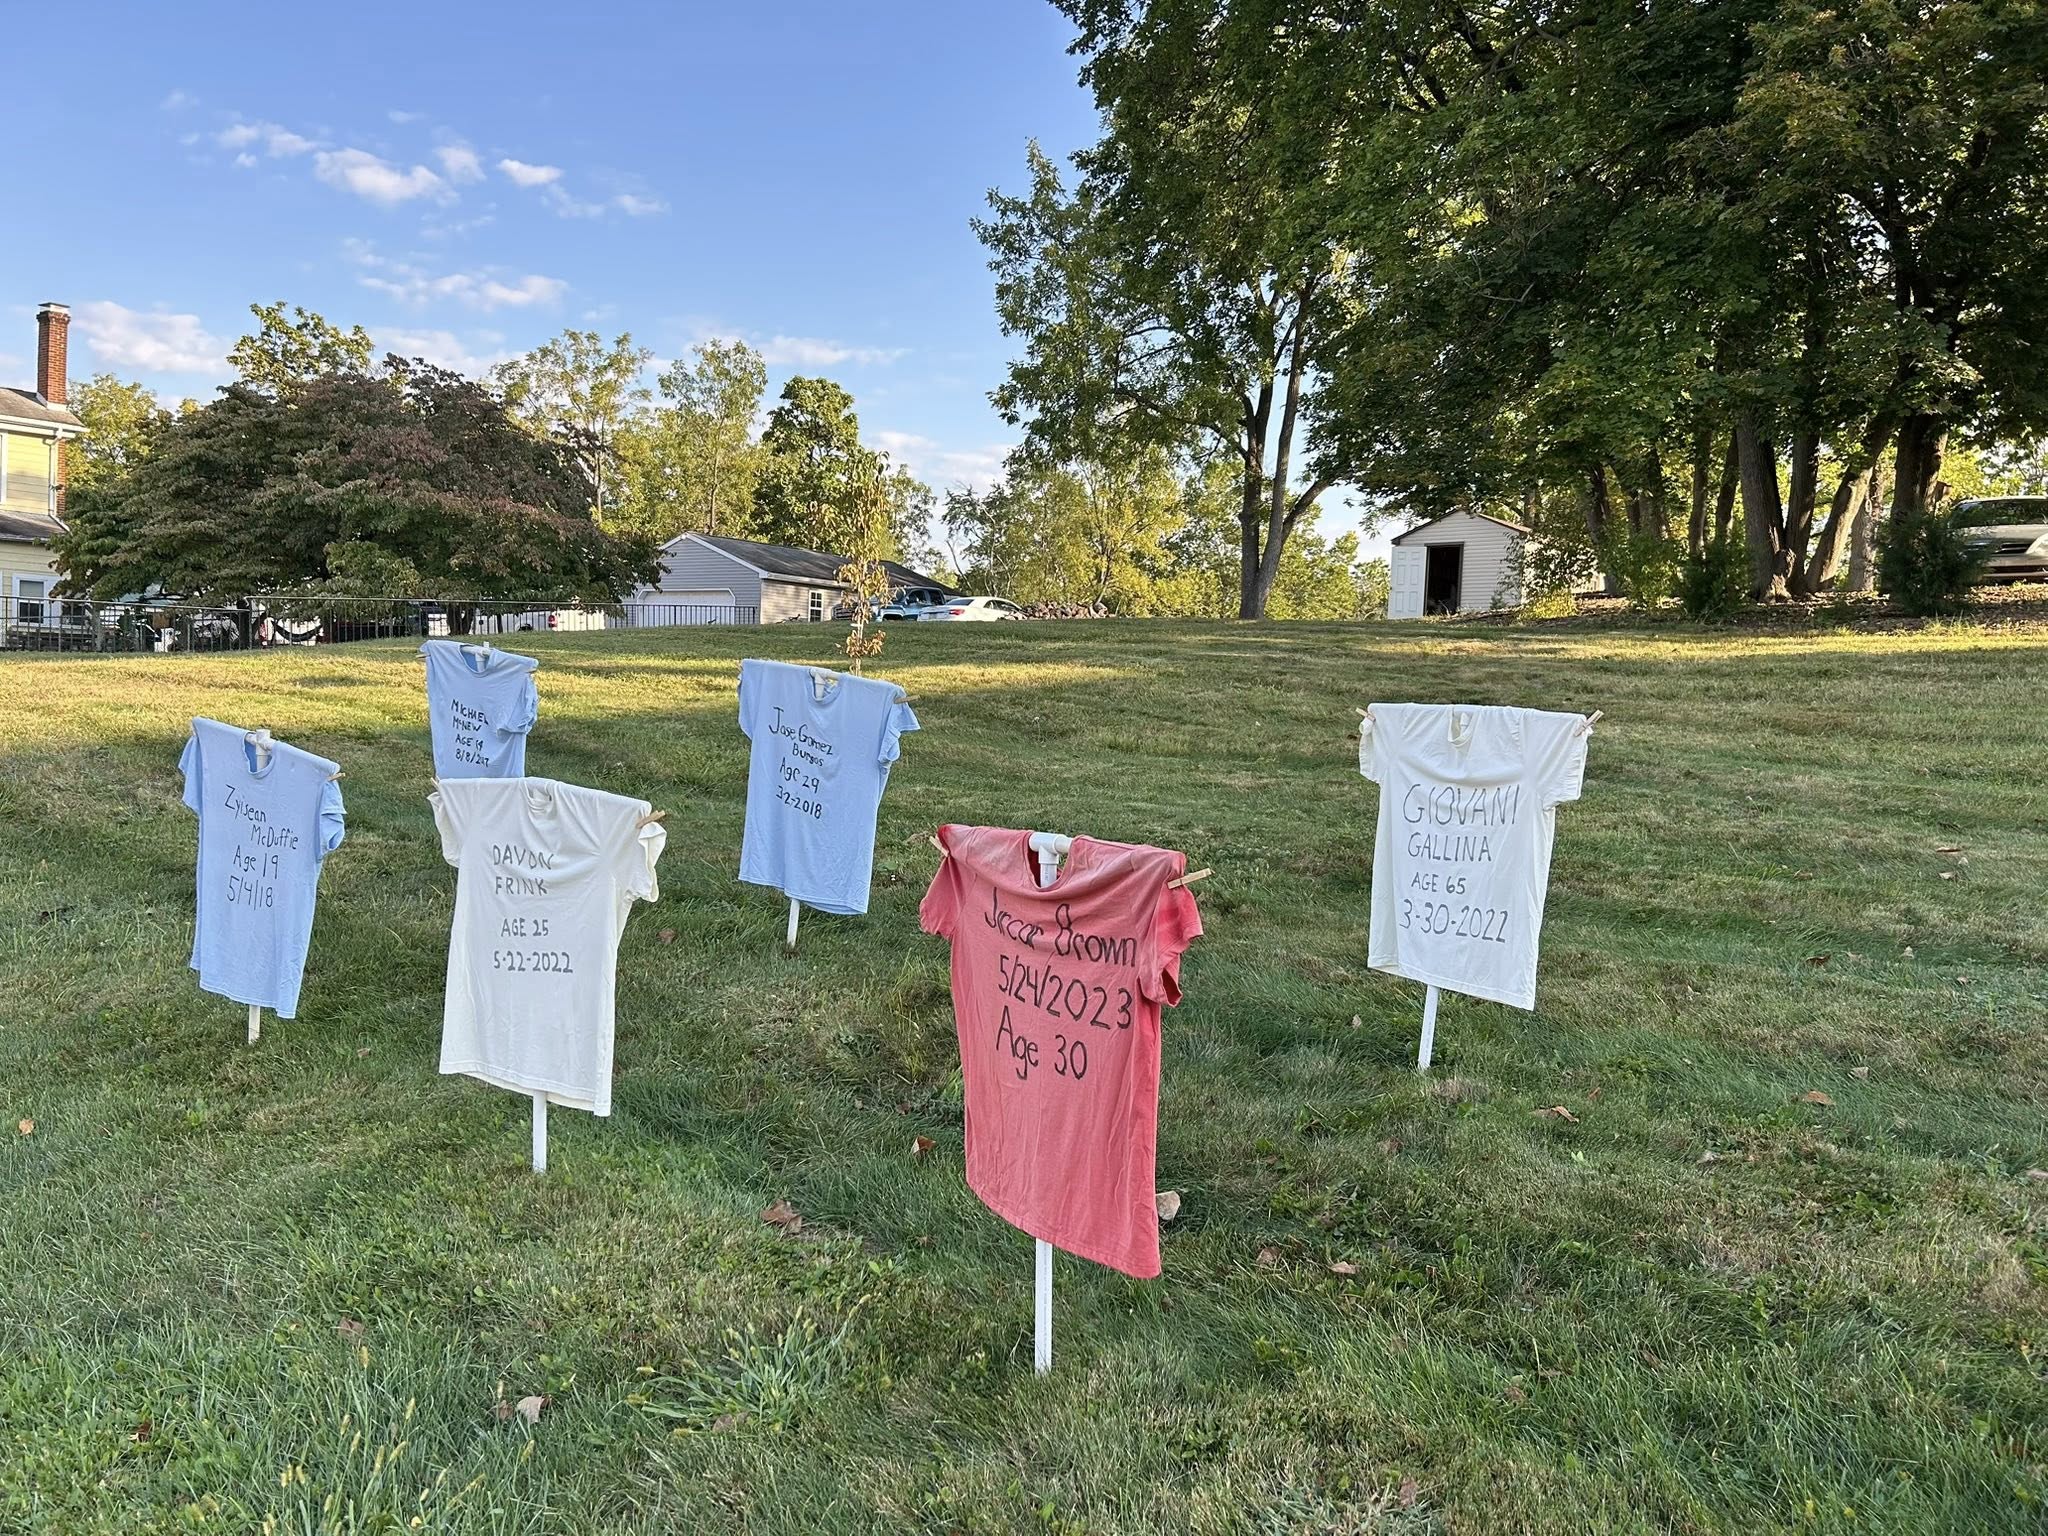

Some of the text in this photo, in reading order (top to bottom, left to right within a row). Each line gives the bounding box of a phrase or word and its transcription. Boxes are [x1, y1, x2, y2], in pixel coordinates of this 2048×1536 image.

[455, 733, 473, 747] AGE
[768, 706, 833, 755] Jose Gomez
[792, 742, 825, 767] Burgos
[779, 757, 820, 794] Age 29
[224, 784, 267, 823] Zyisean
[1403, 783, 1520, 827] GIOVANI
[250, 824, 299, 850] McDuffie
[1407, 831, 1492, 862] GALLINA
[232, 845, 280, 880] Age 19
[492, 844, 554, 870] DAVON
[226, 875, 274, 911] 5/4/18
[495, 876, 548, 896] FRINK
[1411, 871, 1467, 895] AGE 65
[500, 917, 549, 938] AGE 25
[1054, 903, 1138, 968] Brown
[1399, 898, 1509, 944] 3-30-2022
[998, 954, 1134, 1030] 5/24/2023
[996, 1004, 1088, 1080] Age 30
